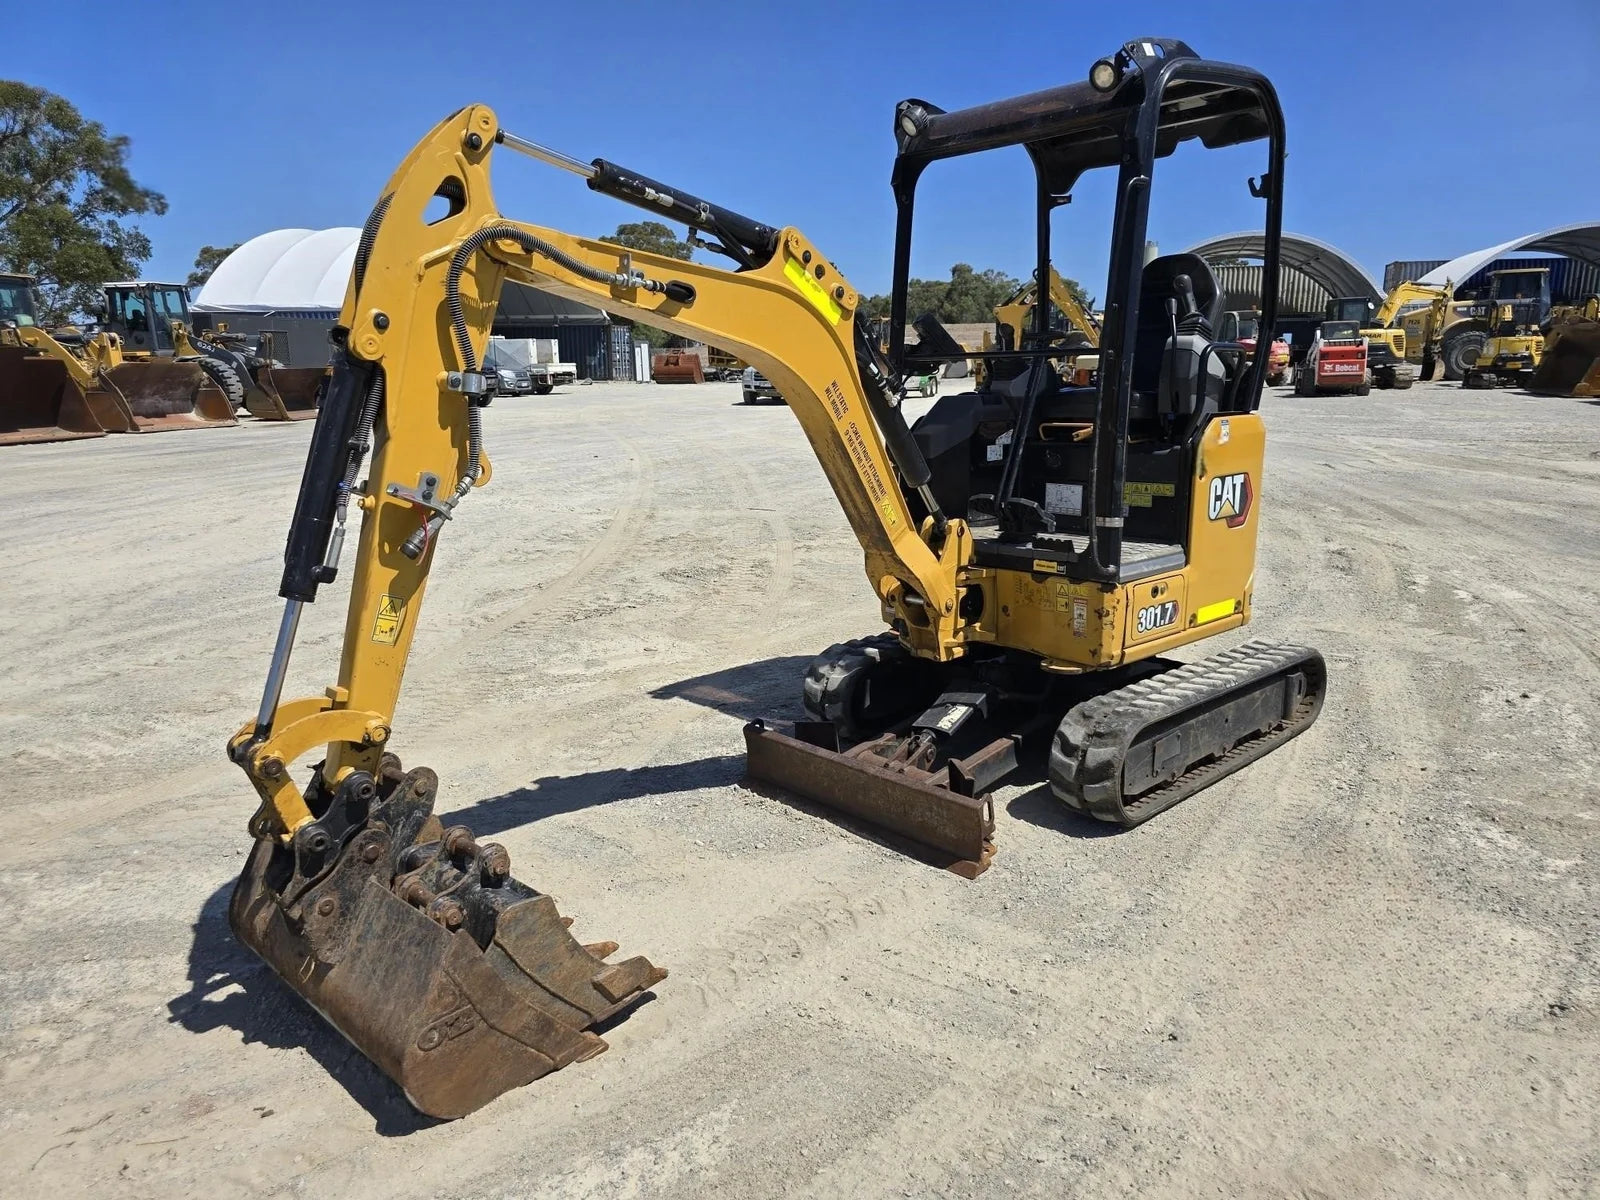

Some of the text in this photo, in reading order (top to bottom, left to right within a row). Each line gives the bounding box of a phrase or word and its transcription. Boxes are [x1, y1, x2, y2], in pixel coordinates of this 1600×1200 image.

[1470, 306, 1486, 316] CAT
[1335, 363, 1360, 373] Bobcat
[831, 380, 840, 394] WLL
[837, 392, 849, 414] STATIC
[858, 439, 871, 462] WITHOUT
[868, 462, 886, 496] ATTACHMENT
[831, 399, 843, 421] MOBILE
[863, 470, 881, 503] ATTACHMENT
[1209, 473, 1245, 519] CAT
[1137, 602, 1174, 633] 301.7
